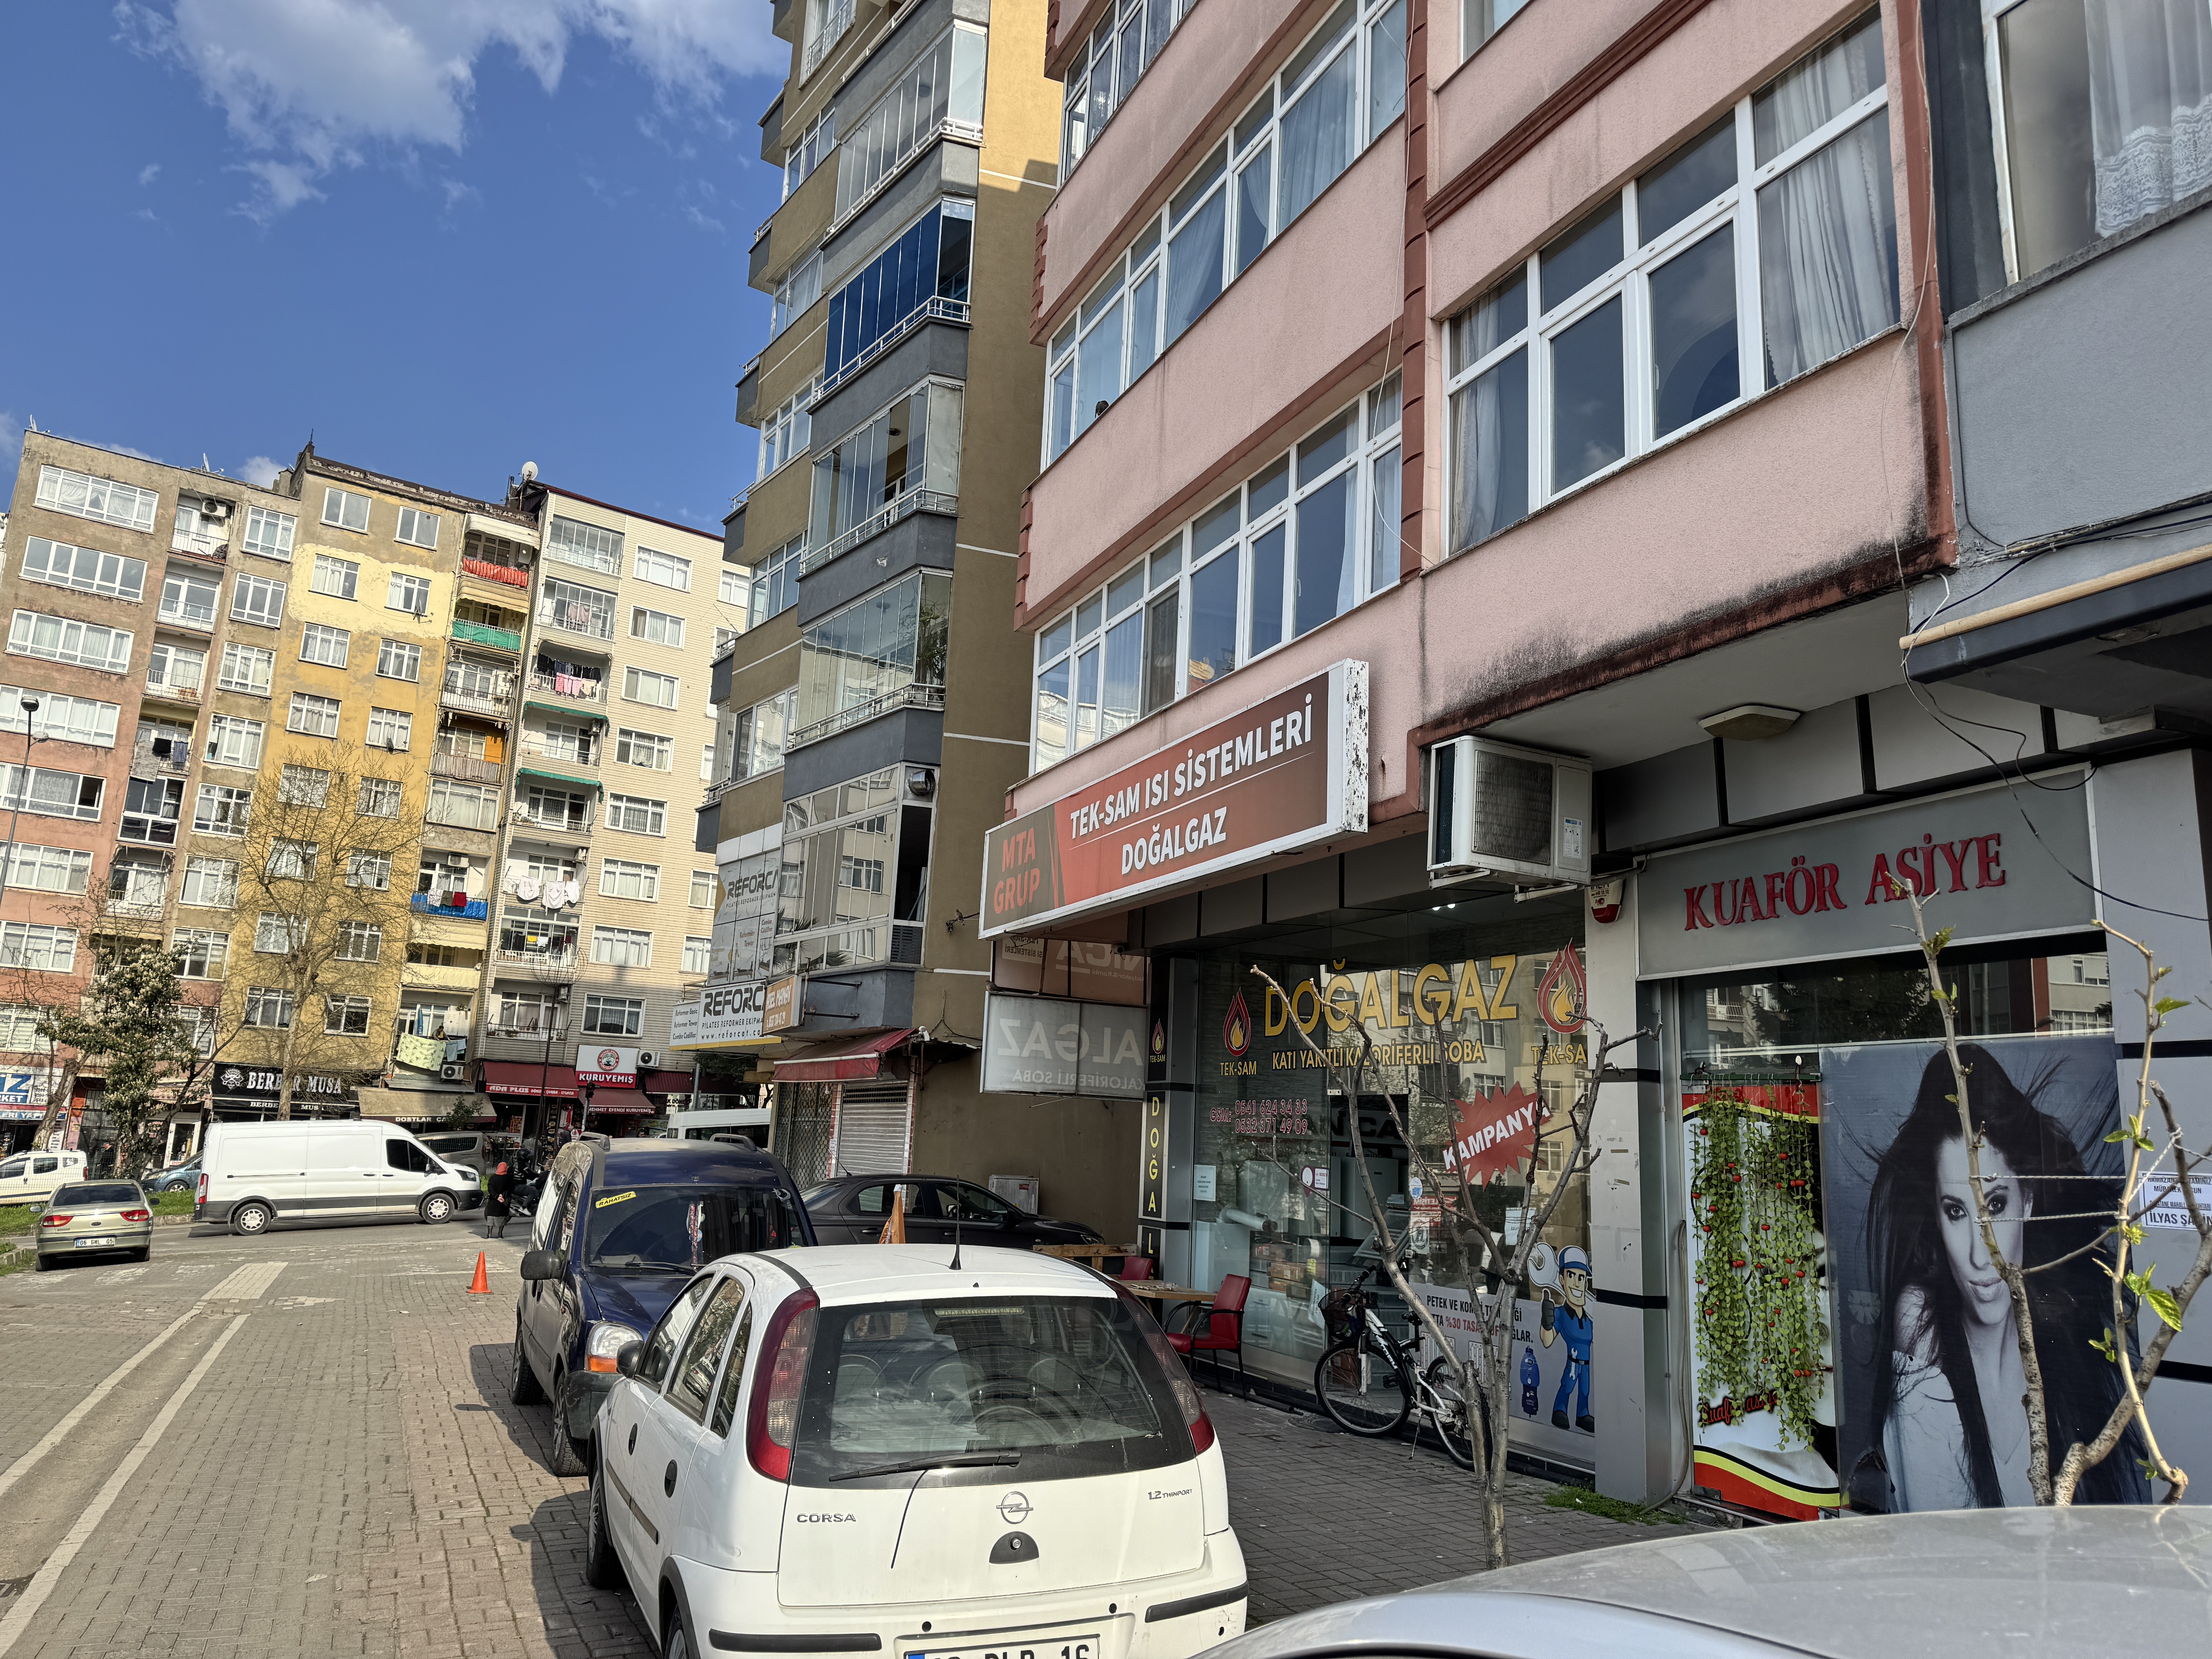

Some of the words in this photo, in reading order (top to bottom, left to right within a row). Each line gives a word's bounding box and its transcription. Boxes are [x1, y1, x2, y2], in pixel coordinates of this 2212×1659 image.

[1070, 778, 1140, 840] TEK-SAM
[1145, 769, 1169, 809] ISI
[1174, 693, 1312, 797] SİSTEMLERİ
[1121, 806, 1227, 875] DOĞALGAZ
[1002, 827, 1036, 873] MTA
[1684, 855, 1847, 931] KUAFÖR
[1865, 833, 2006, 905] ASİYE
[994, 868, 1040, 915] GRUP
[740, 895, 759, 905] REFORMER
[703, 986, 764, 1017] REFORC
[1265, 954, 1518, 1037] DOĞALGAZ
[702, 1020, 719, 1029] PİLATES
[720, 1018, 744, 1027] REFORMER
[1272, 1050, 1296, 1069] KATI
[1220, 1061, 1257, 1076] TEK-SAM
[247, 1072, 301, 1092] BERBR
[306, 1075, 342, 1094] MUSA
[579, 1073, 634, 1084] KURUYEMİŞ
[1210, 1107, 1231, 1122] GSM:
[1235, 1100, 1256, 1115] 0541
[1260, 1099, 1277, 1115] 624
[1280, 1099, 1292, 1115] 34
[1295, 1099, 1308, 1115] 33
[1235, 1118, 1257, 1133] 0532
[1260, 1118, 1276, 1133] 371
[1280, 1118, 1292, 1133] 49
[1294, 1118, 1308, 1134] 09
[599, 1193, 632, 1206] RAHATSIZ
[2150, 1211, 2178, 1224] İLYAS
[2181, 1214, 2212, 1226] ŞAİN
[1427, 1295, 1447, 1309] PETEK
[1449, 1299, 1458, 1311] VE
[1446, 1316, 1461, 1329] %30
[797, 1513, 856, 1523] CORSA
